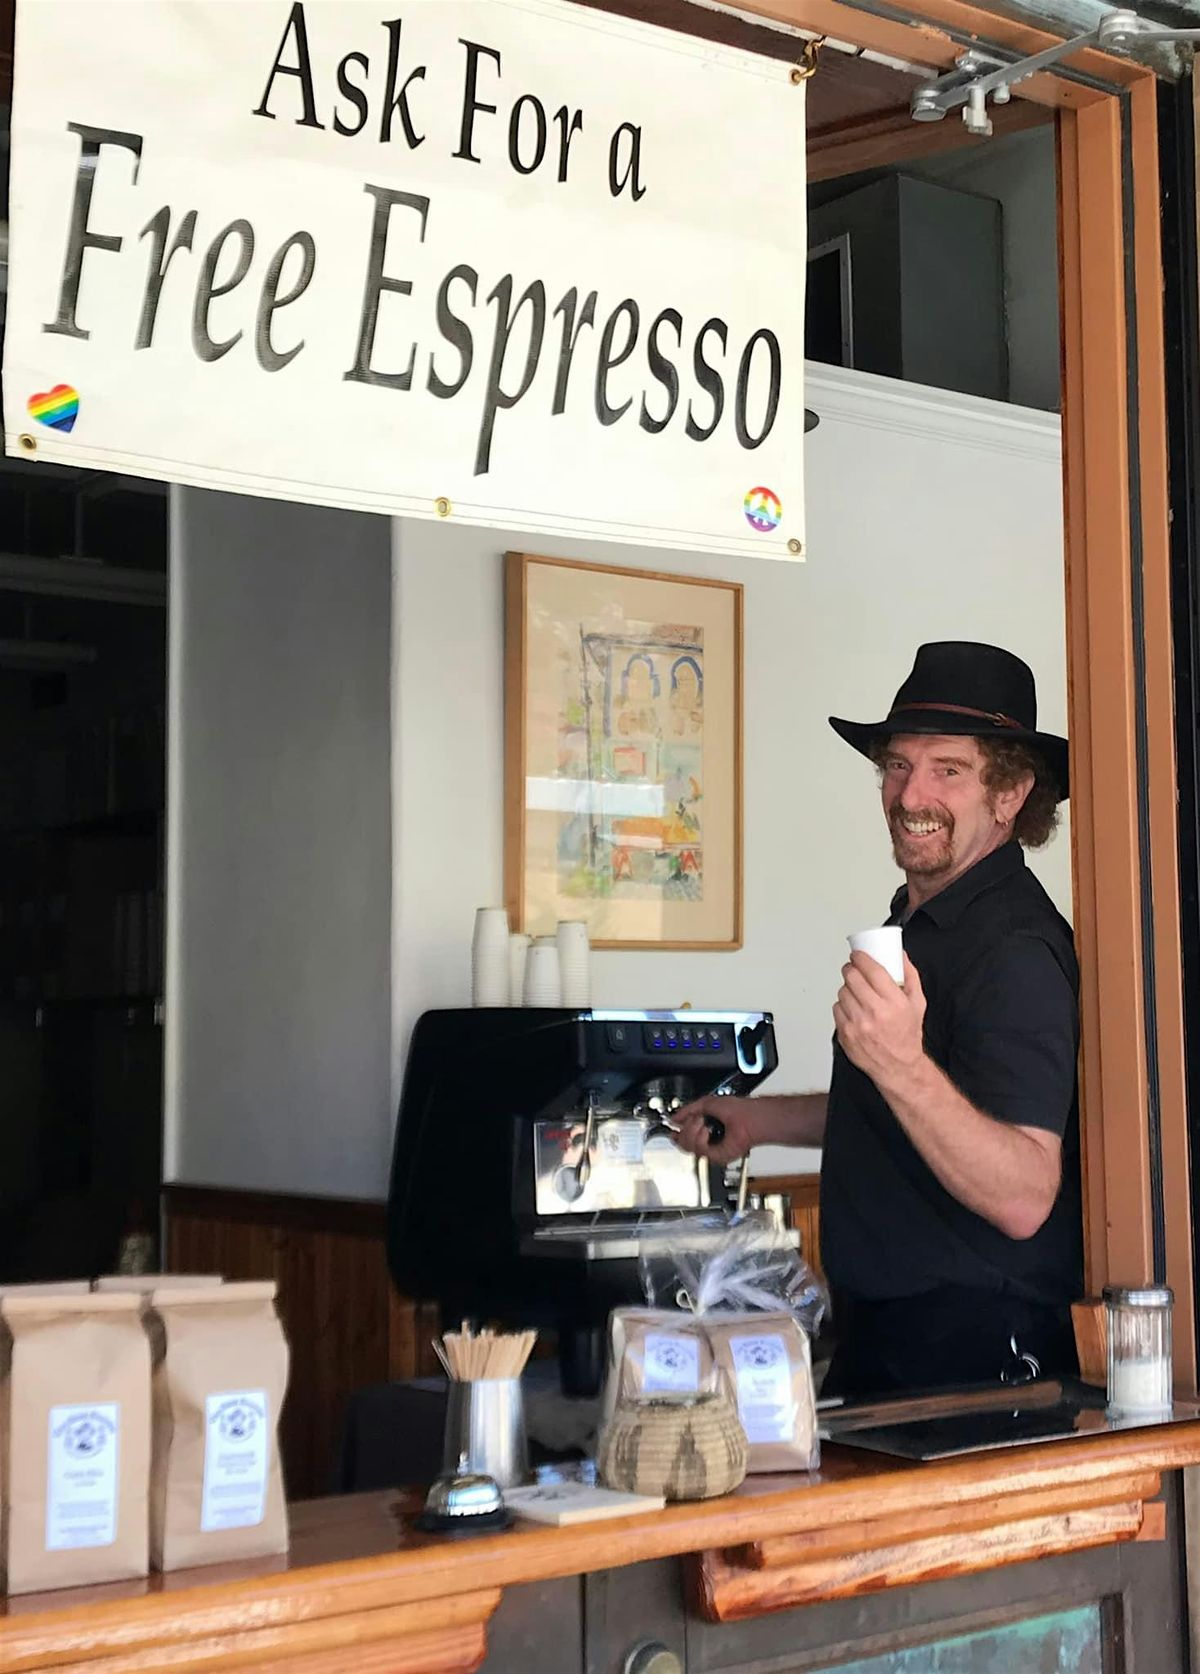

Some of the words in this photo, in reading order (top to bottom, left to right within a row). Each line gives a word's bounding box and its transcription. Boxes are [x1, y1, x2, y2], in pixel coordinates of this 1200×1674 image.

[252, 2, 427, 150] Ask
[451, 38, 583, 183] For
[608, 121, 647, 201] a
[42, 121, 316, 372] Free
[343, 183, 782, 476] Espresso
